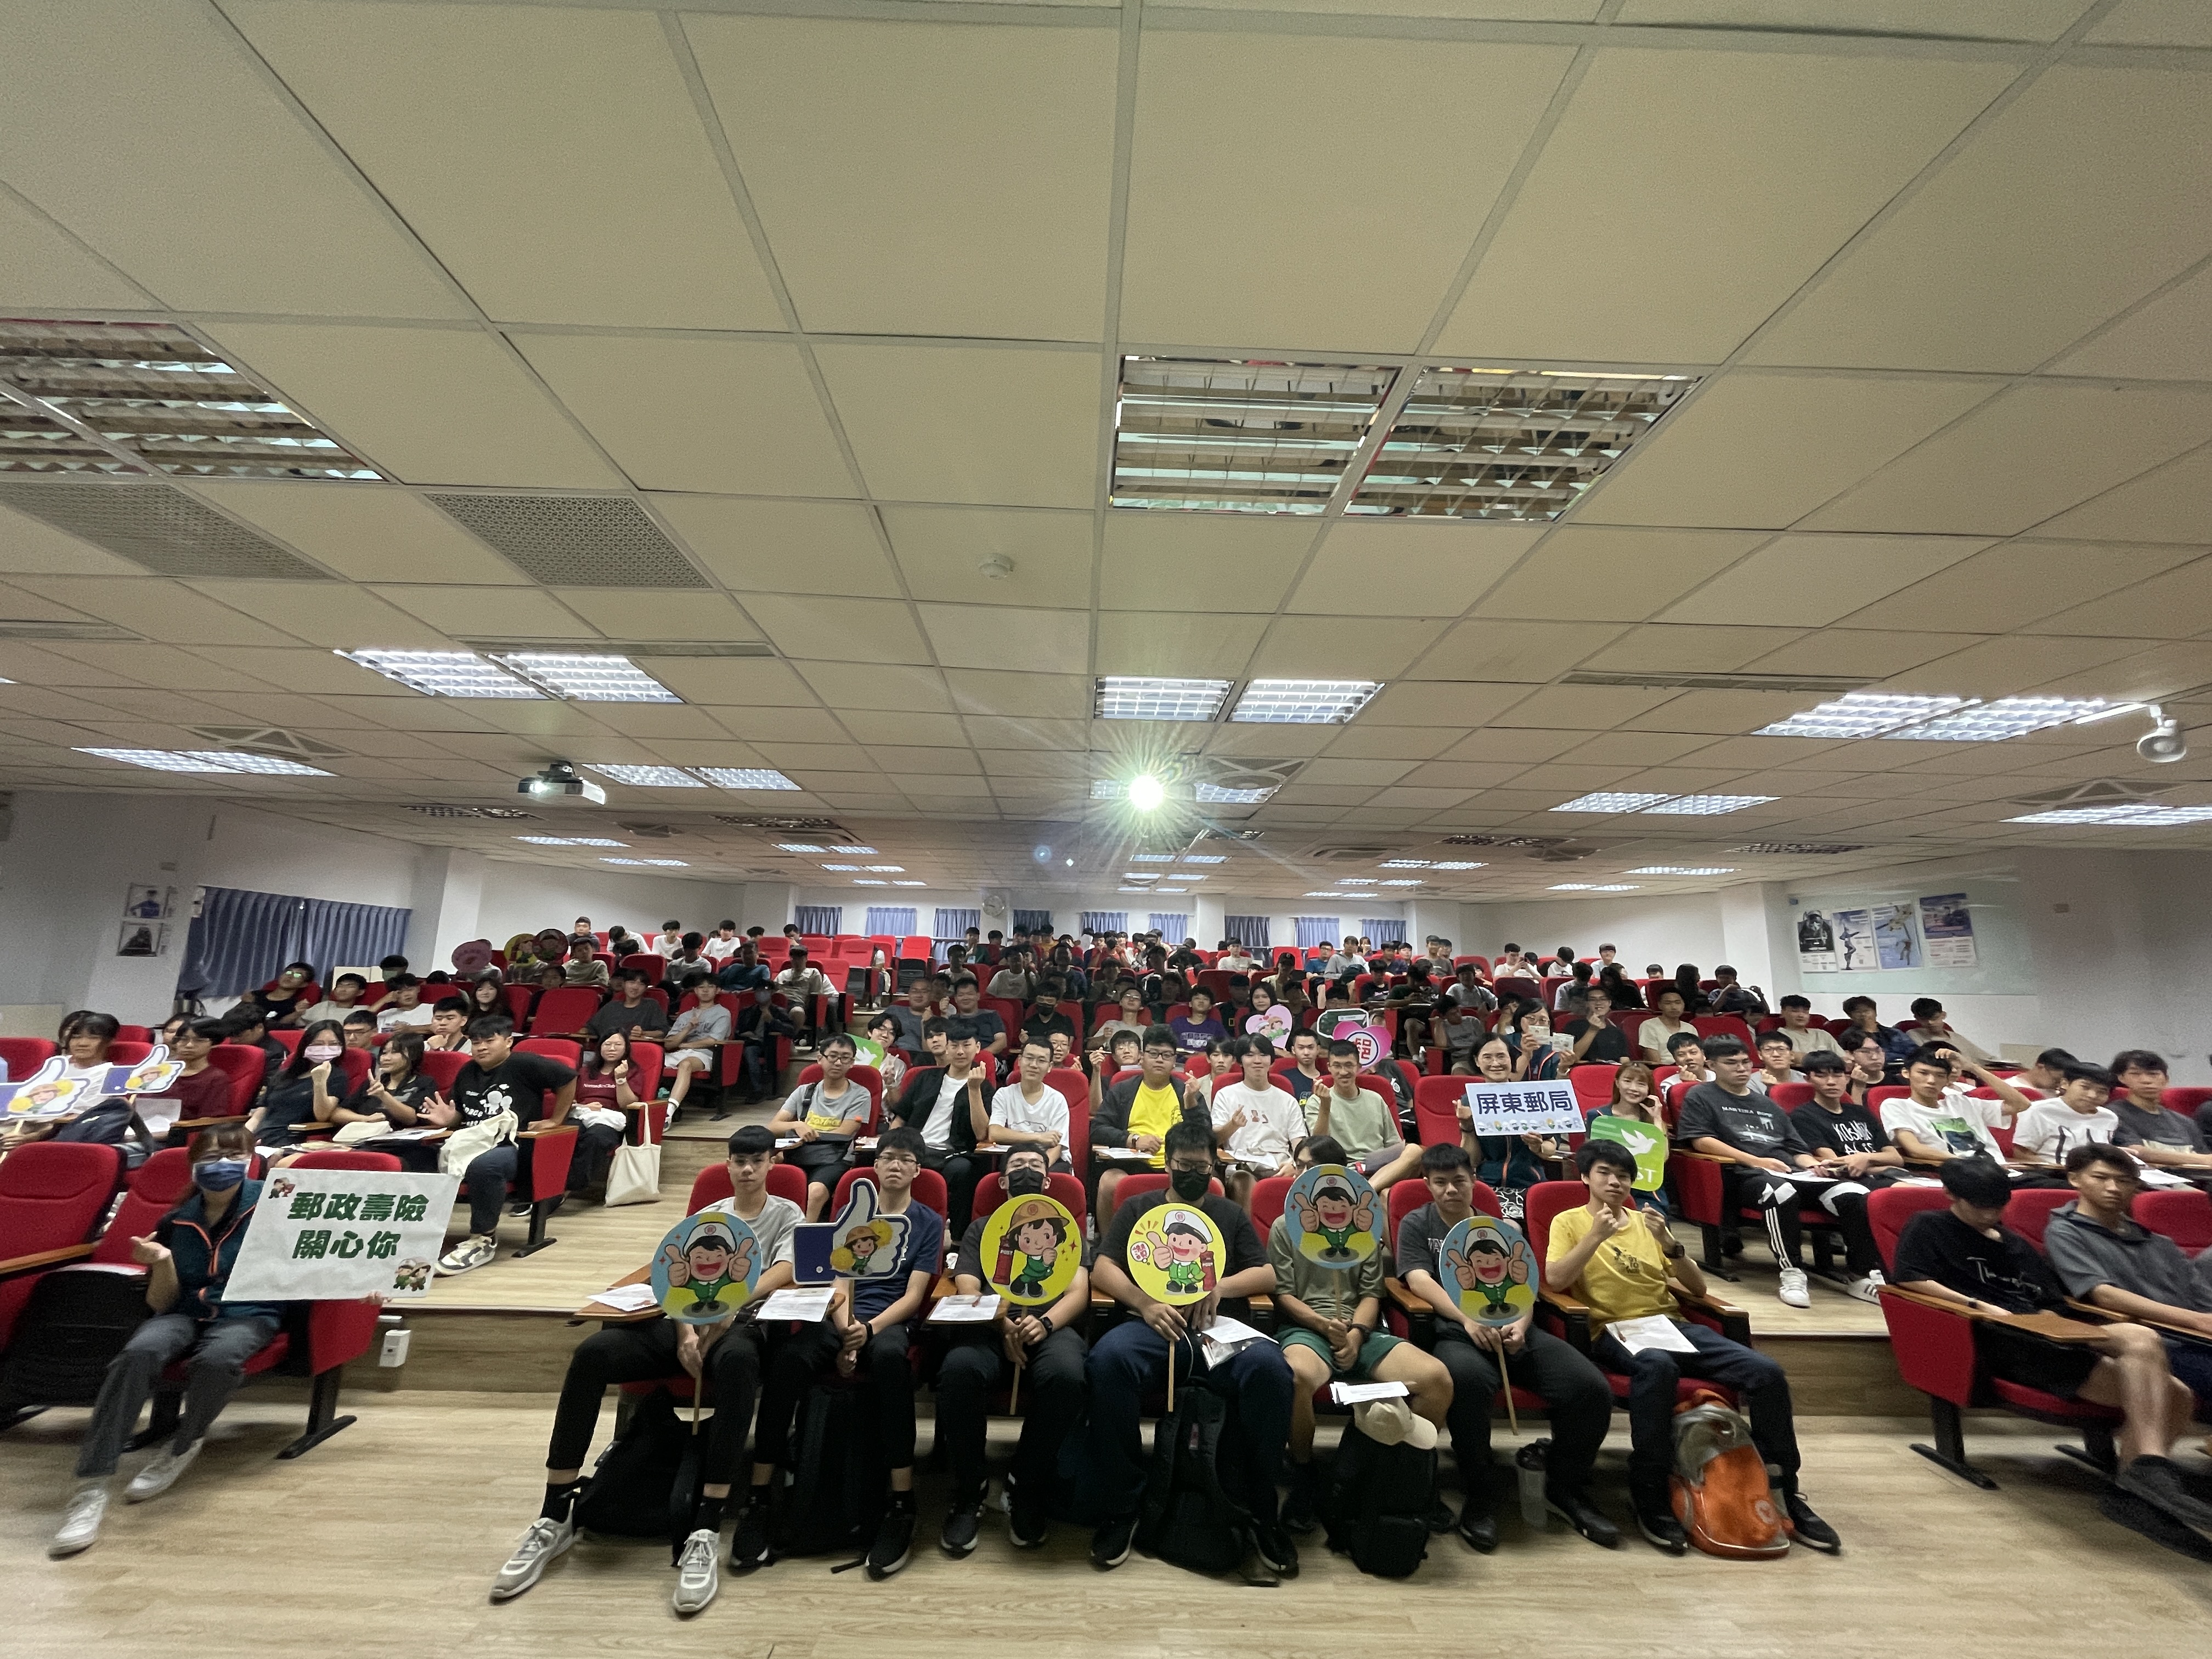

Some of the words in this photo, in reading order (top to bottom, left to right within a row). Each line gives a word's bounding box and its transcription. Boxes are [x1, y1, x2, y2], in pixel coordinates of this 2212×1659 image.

[1476, 1090, 1573, 1114] 屏東郵局
[287, 1192, 430, 1222] 郵政壽險
[292, 1229, 401, 1259] 關心你
